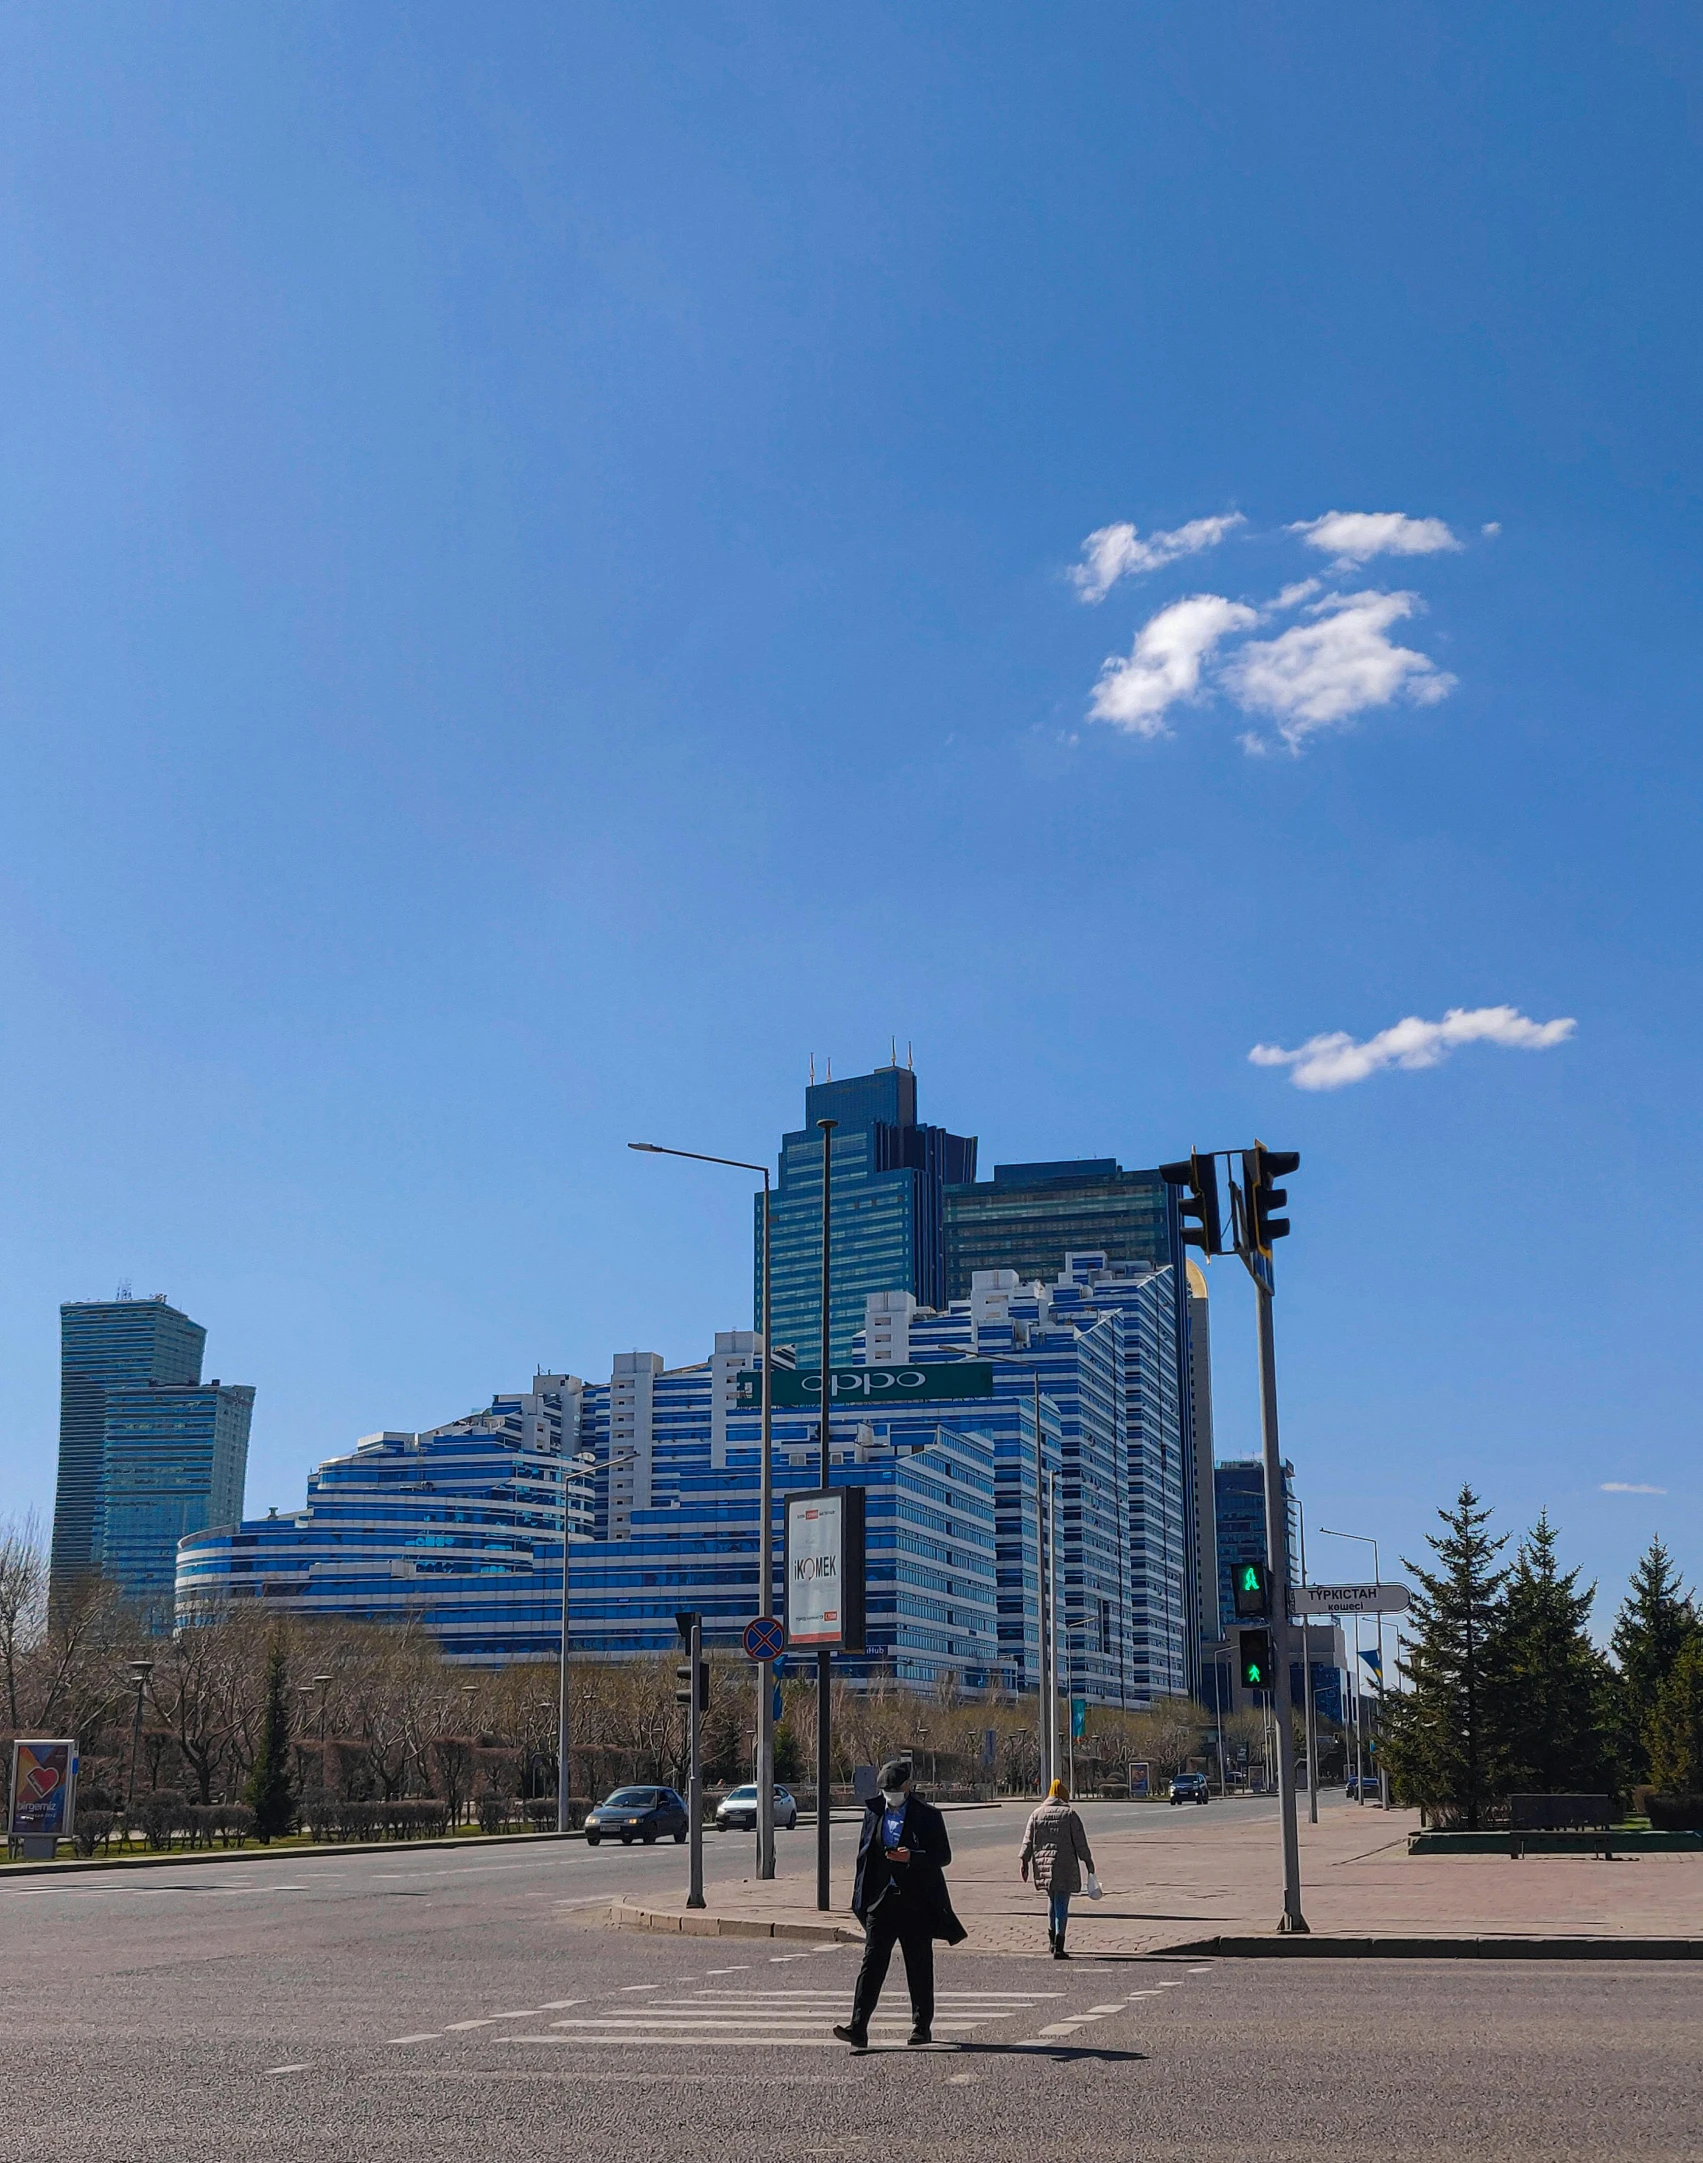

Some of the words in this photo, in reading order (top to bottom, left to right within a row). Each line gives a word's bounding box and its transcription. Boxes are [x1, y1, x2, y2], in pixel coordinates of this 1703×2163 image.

[801, 1371, 926, 1397] oppo
[1308, 1588, 1378, 1601] ТҮРКІСТАН
[1328, 1602, 1364, 1611] көшесі
